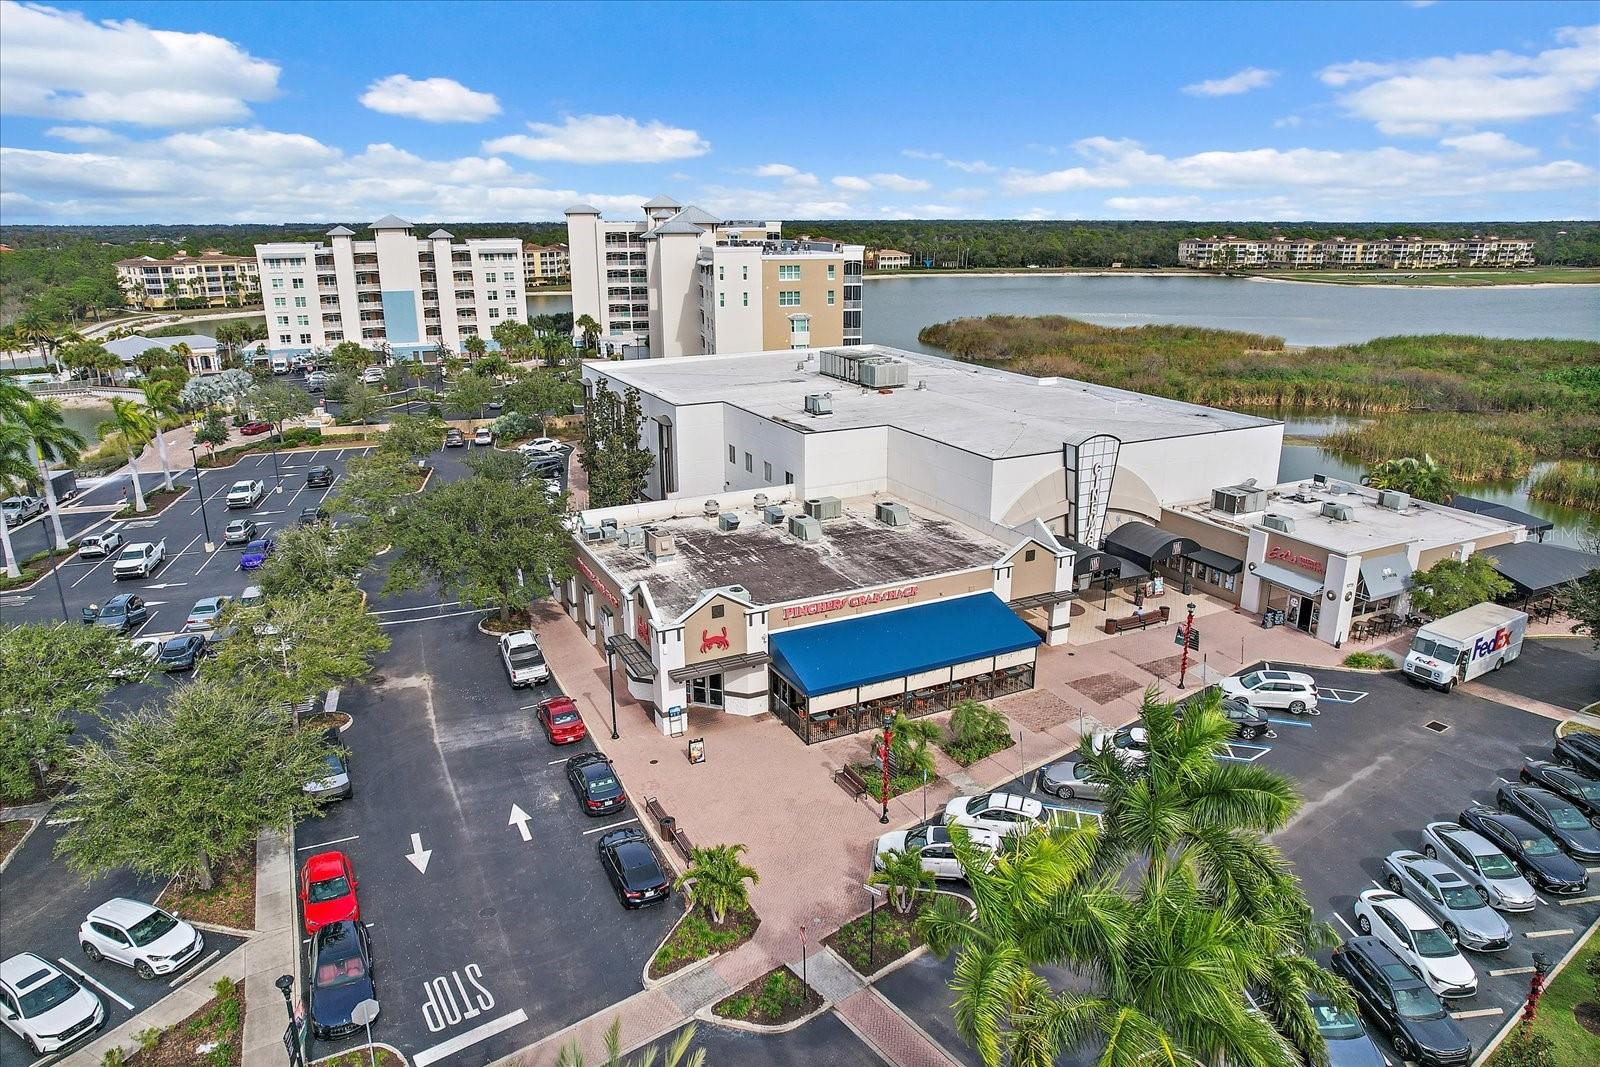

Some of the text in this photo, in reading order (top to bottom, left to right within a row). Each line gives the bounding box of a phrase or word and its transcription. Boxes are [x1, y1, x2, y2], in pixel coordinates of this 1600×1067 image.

[1472, 627, 1513, 661] FedEx
[1415, 656, 1439, 668] FedEx
[421, 963, 496, 1033] STOP
